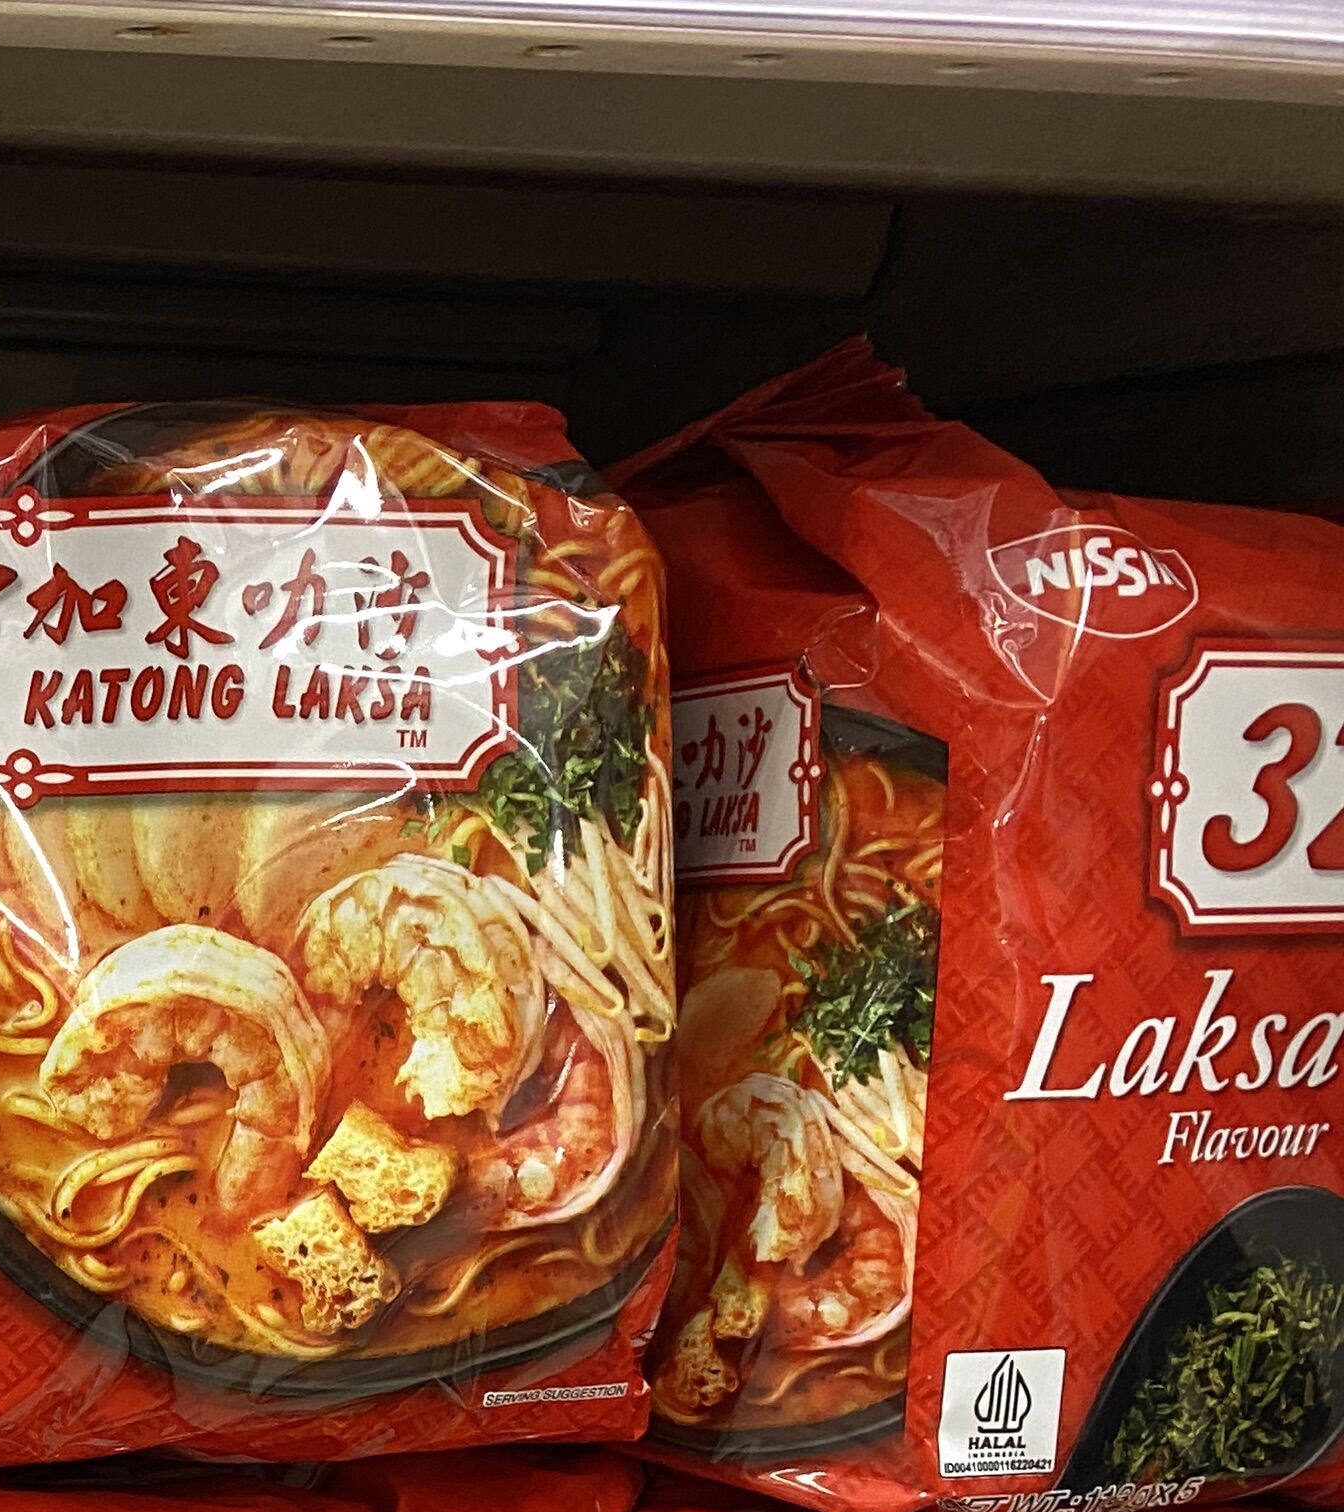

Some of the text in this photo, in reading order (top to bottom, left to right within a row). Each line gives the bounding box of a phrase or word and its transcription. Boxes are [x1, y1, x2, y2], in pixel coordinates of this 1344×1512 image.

[23, 664, 432, 728] KATONG LAKSA
[396, 728, 429, 749] TM
[1003, 968, 1344, 1101] Laksa
[1156, 1111, 1330, 1166] Flavour
[485, 1382, 628, 1407] SERVING SUGGESTION
[968, 1436, 1026, 1450] HALAL
